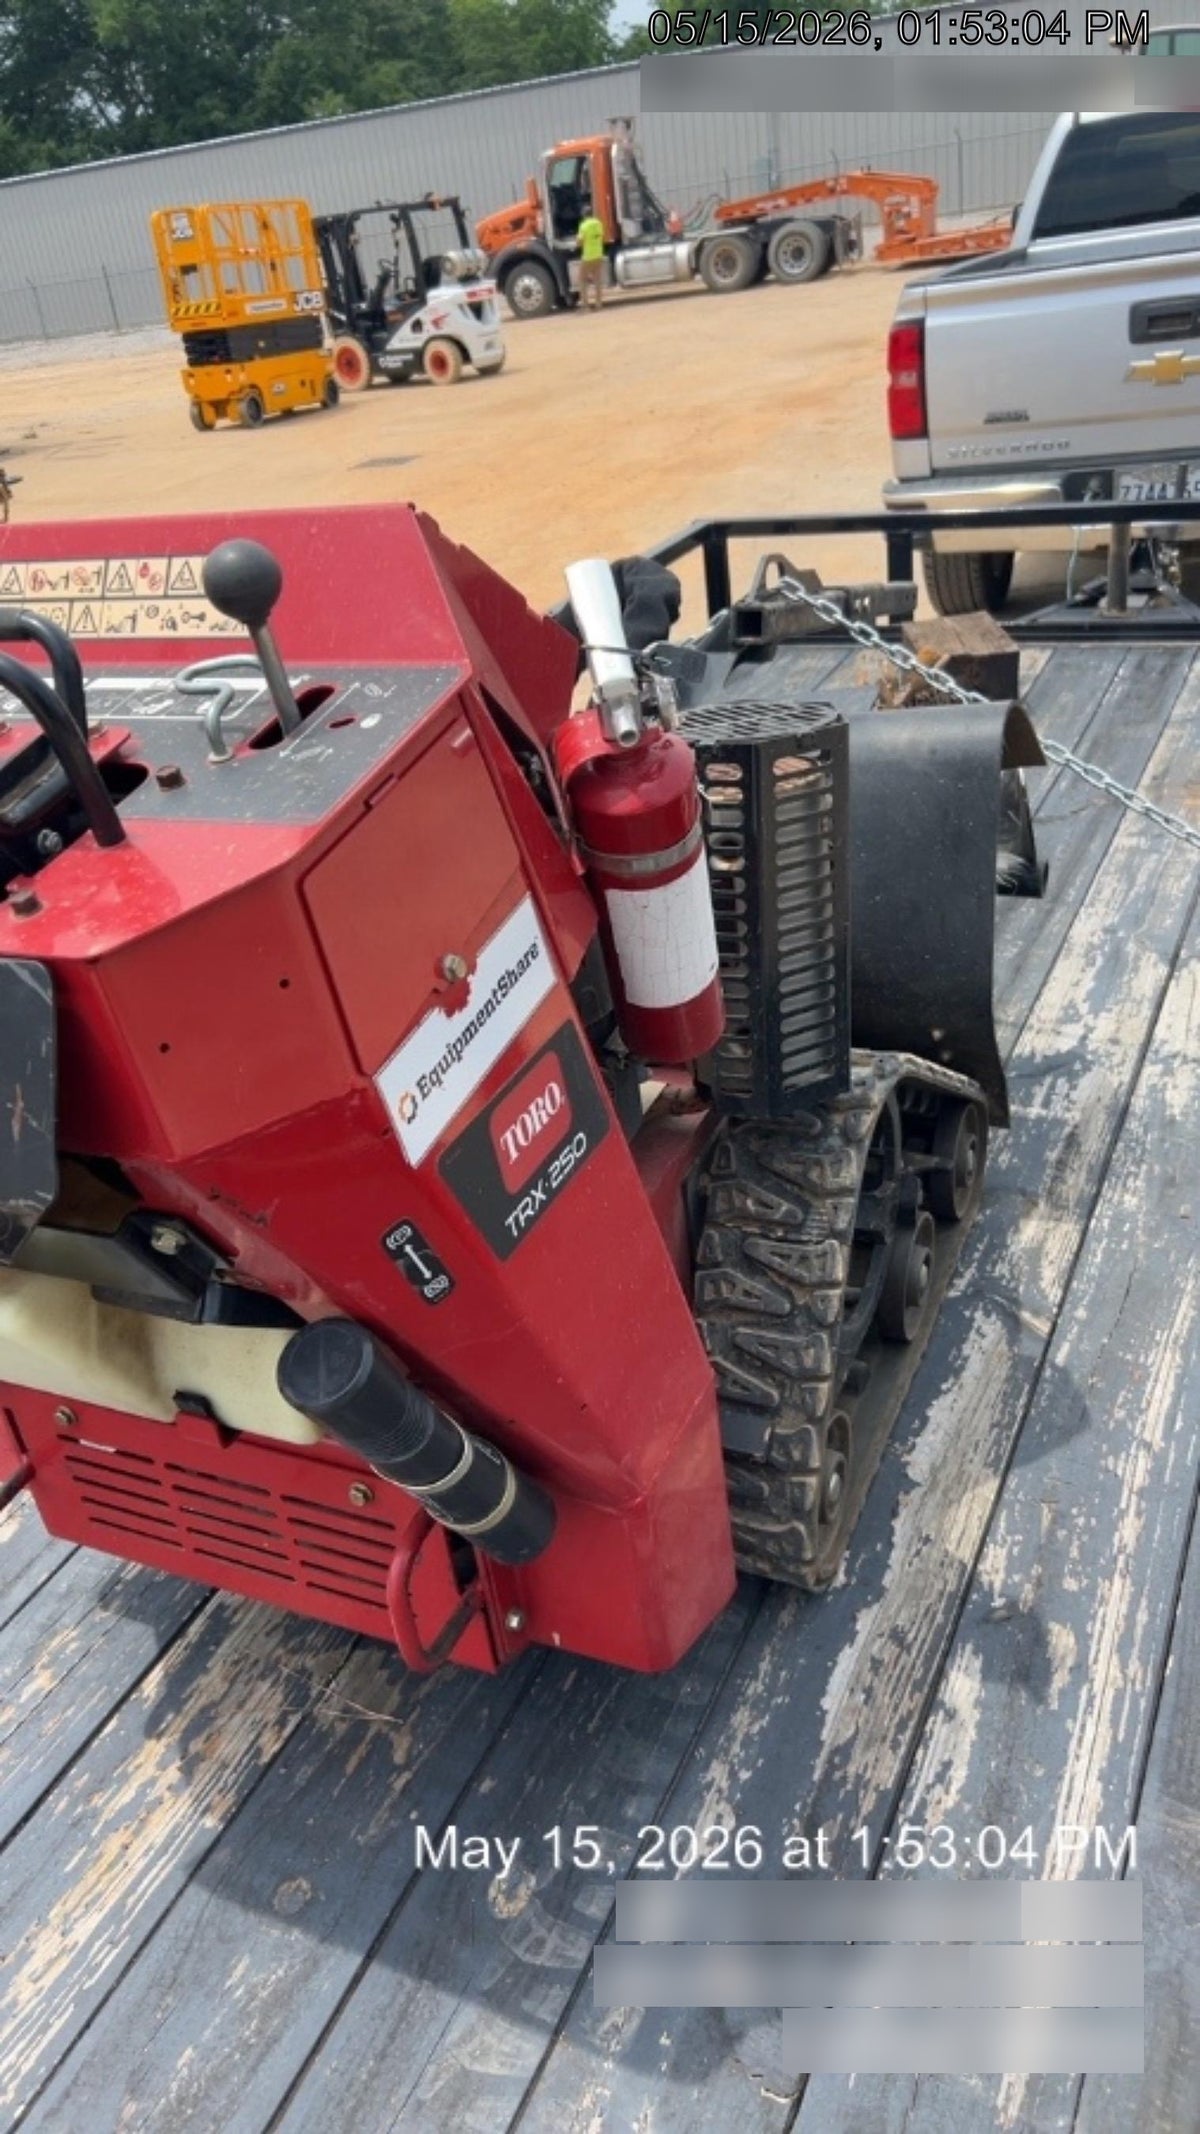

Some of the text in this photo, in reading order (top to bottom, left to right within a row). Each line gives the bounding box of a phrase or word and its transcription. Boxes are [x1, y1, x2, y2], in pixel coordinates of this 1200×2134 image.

[294, 291, 323, 311] JCB
[415, 943, 540, 1101] EquipmentShare
[500, 1082, 561, 1165] TORO
